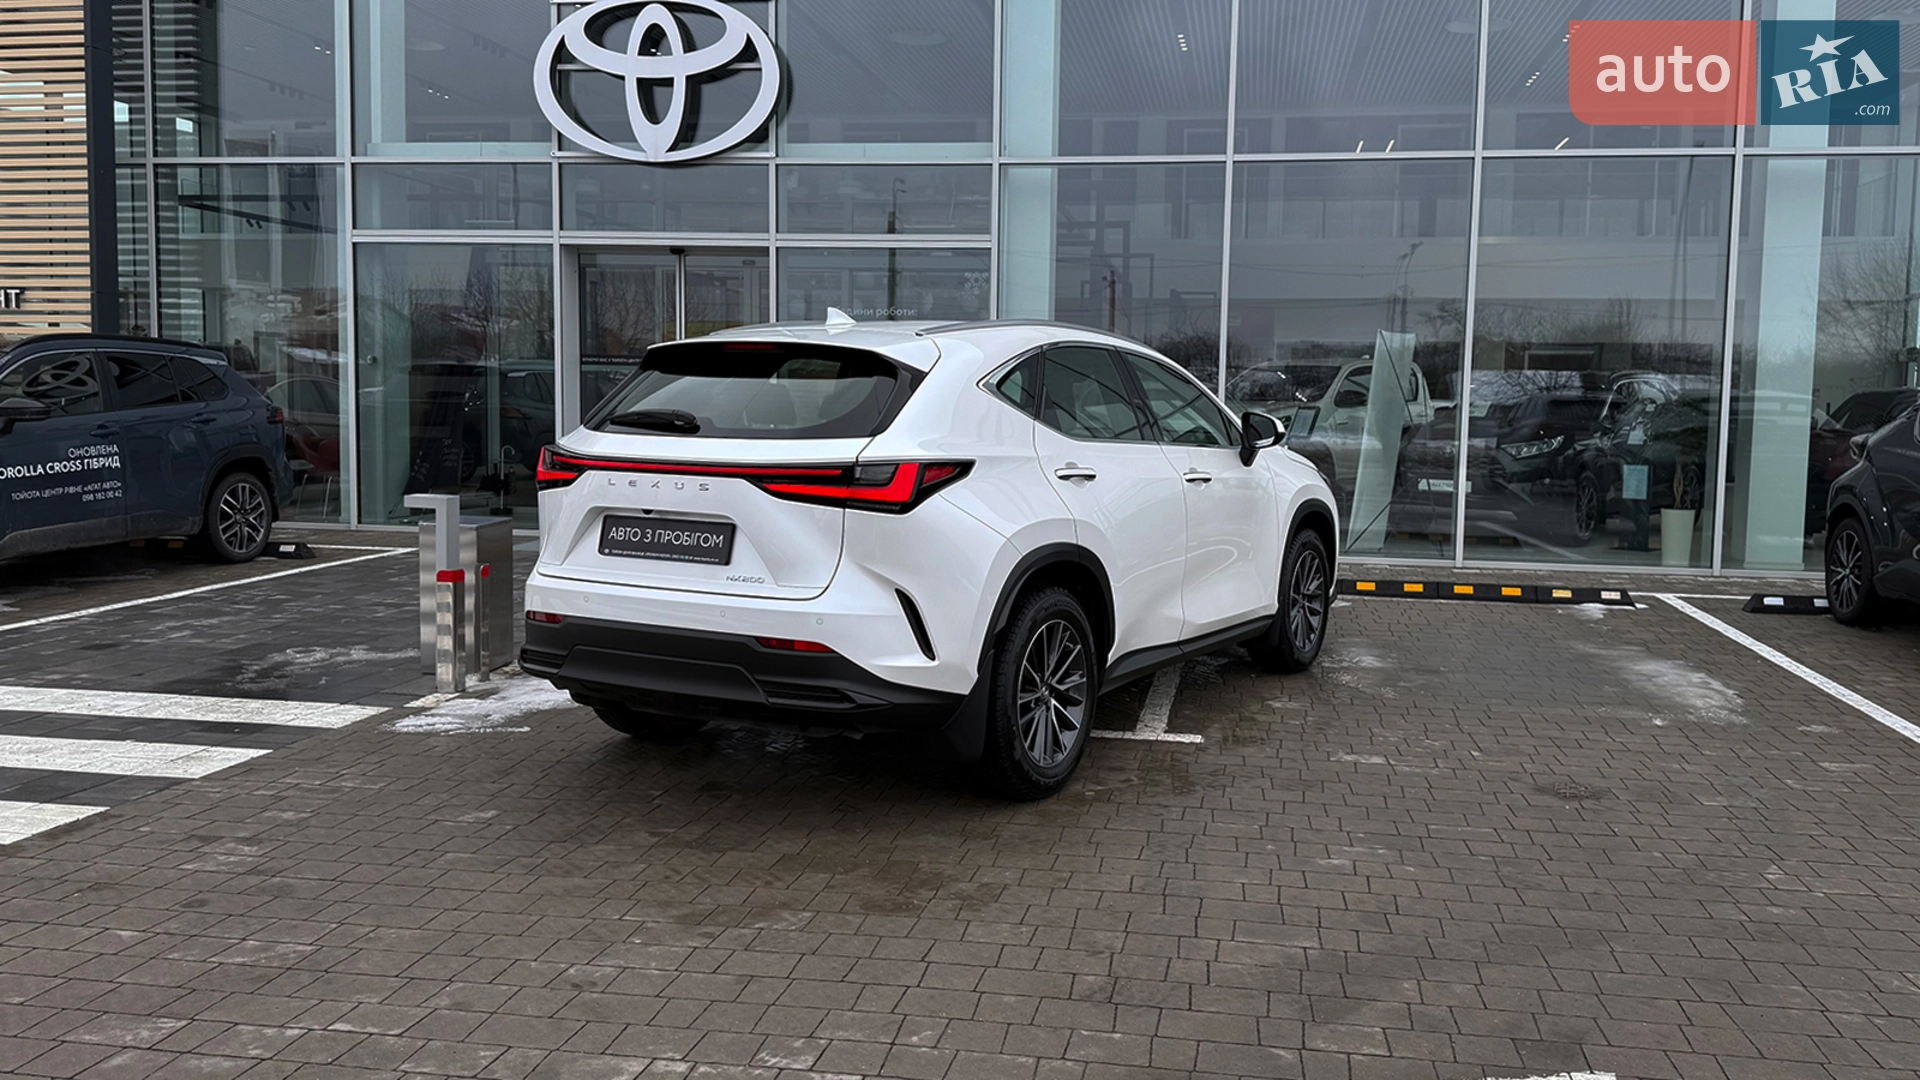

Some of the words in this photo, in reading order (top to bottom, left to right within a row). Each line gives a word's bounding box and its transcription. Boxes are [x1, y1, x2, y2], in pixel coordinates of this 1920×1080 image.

[875, 305, 919, 319] роботи:
[67, 444, 120, 458] ОНОВЛЕНА
[46, 459, 83, 475] CROSS
[84, 455, 121, 470] ГІБРИД
[608, 477, 710, 492] LEXUS
[11, 491, 41, 500] ТОЙОТА
[41, 487, 63, 497] ЦЕНТР
[608, 526, 642, 542] АВТО
[654, 529, 724, 548] ПРОБІГОМ
